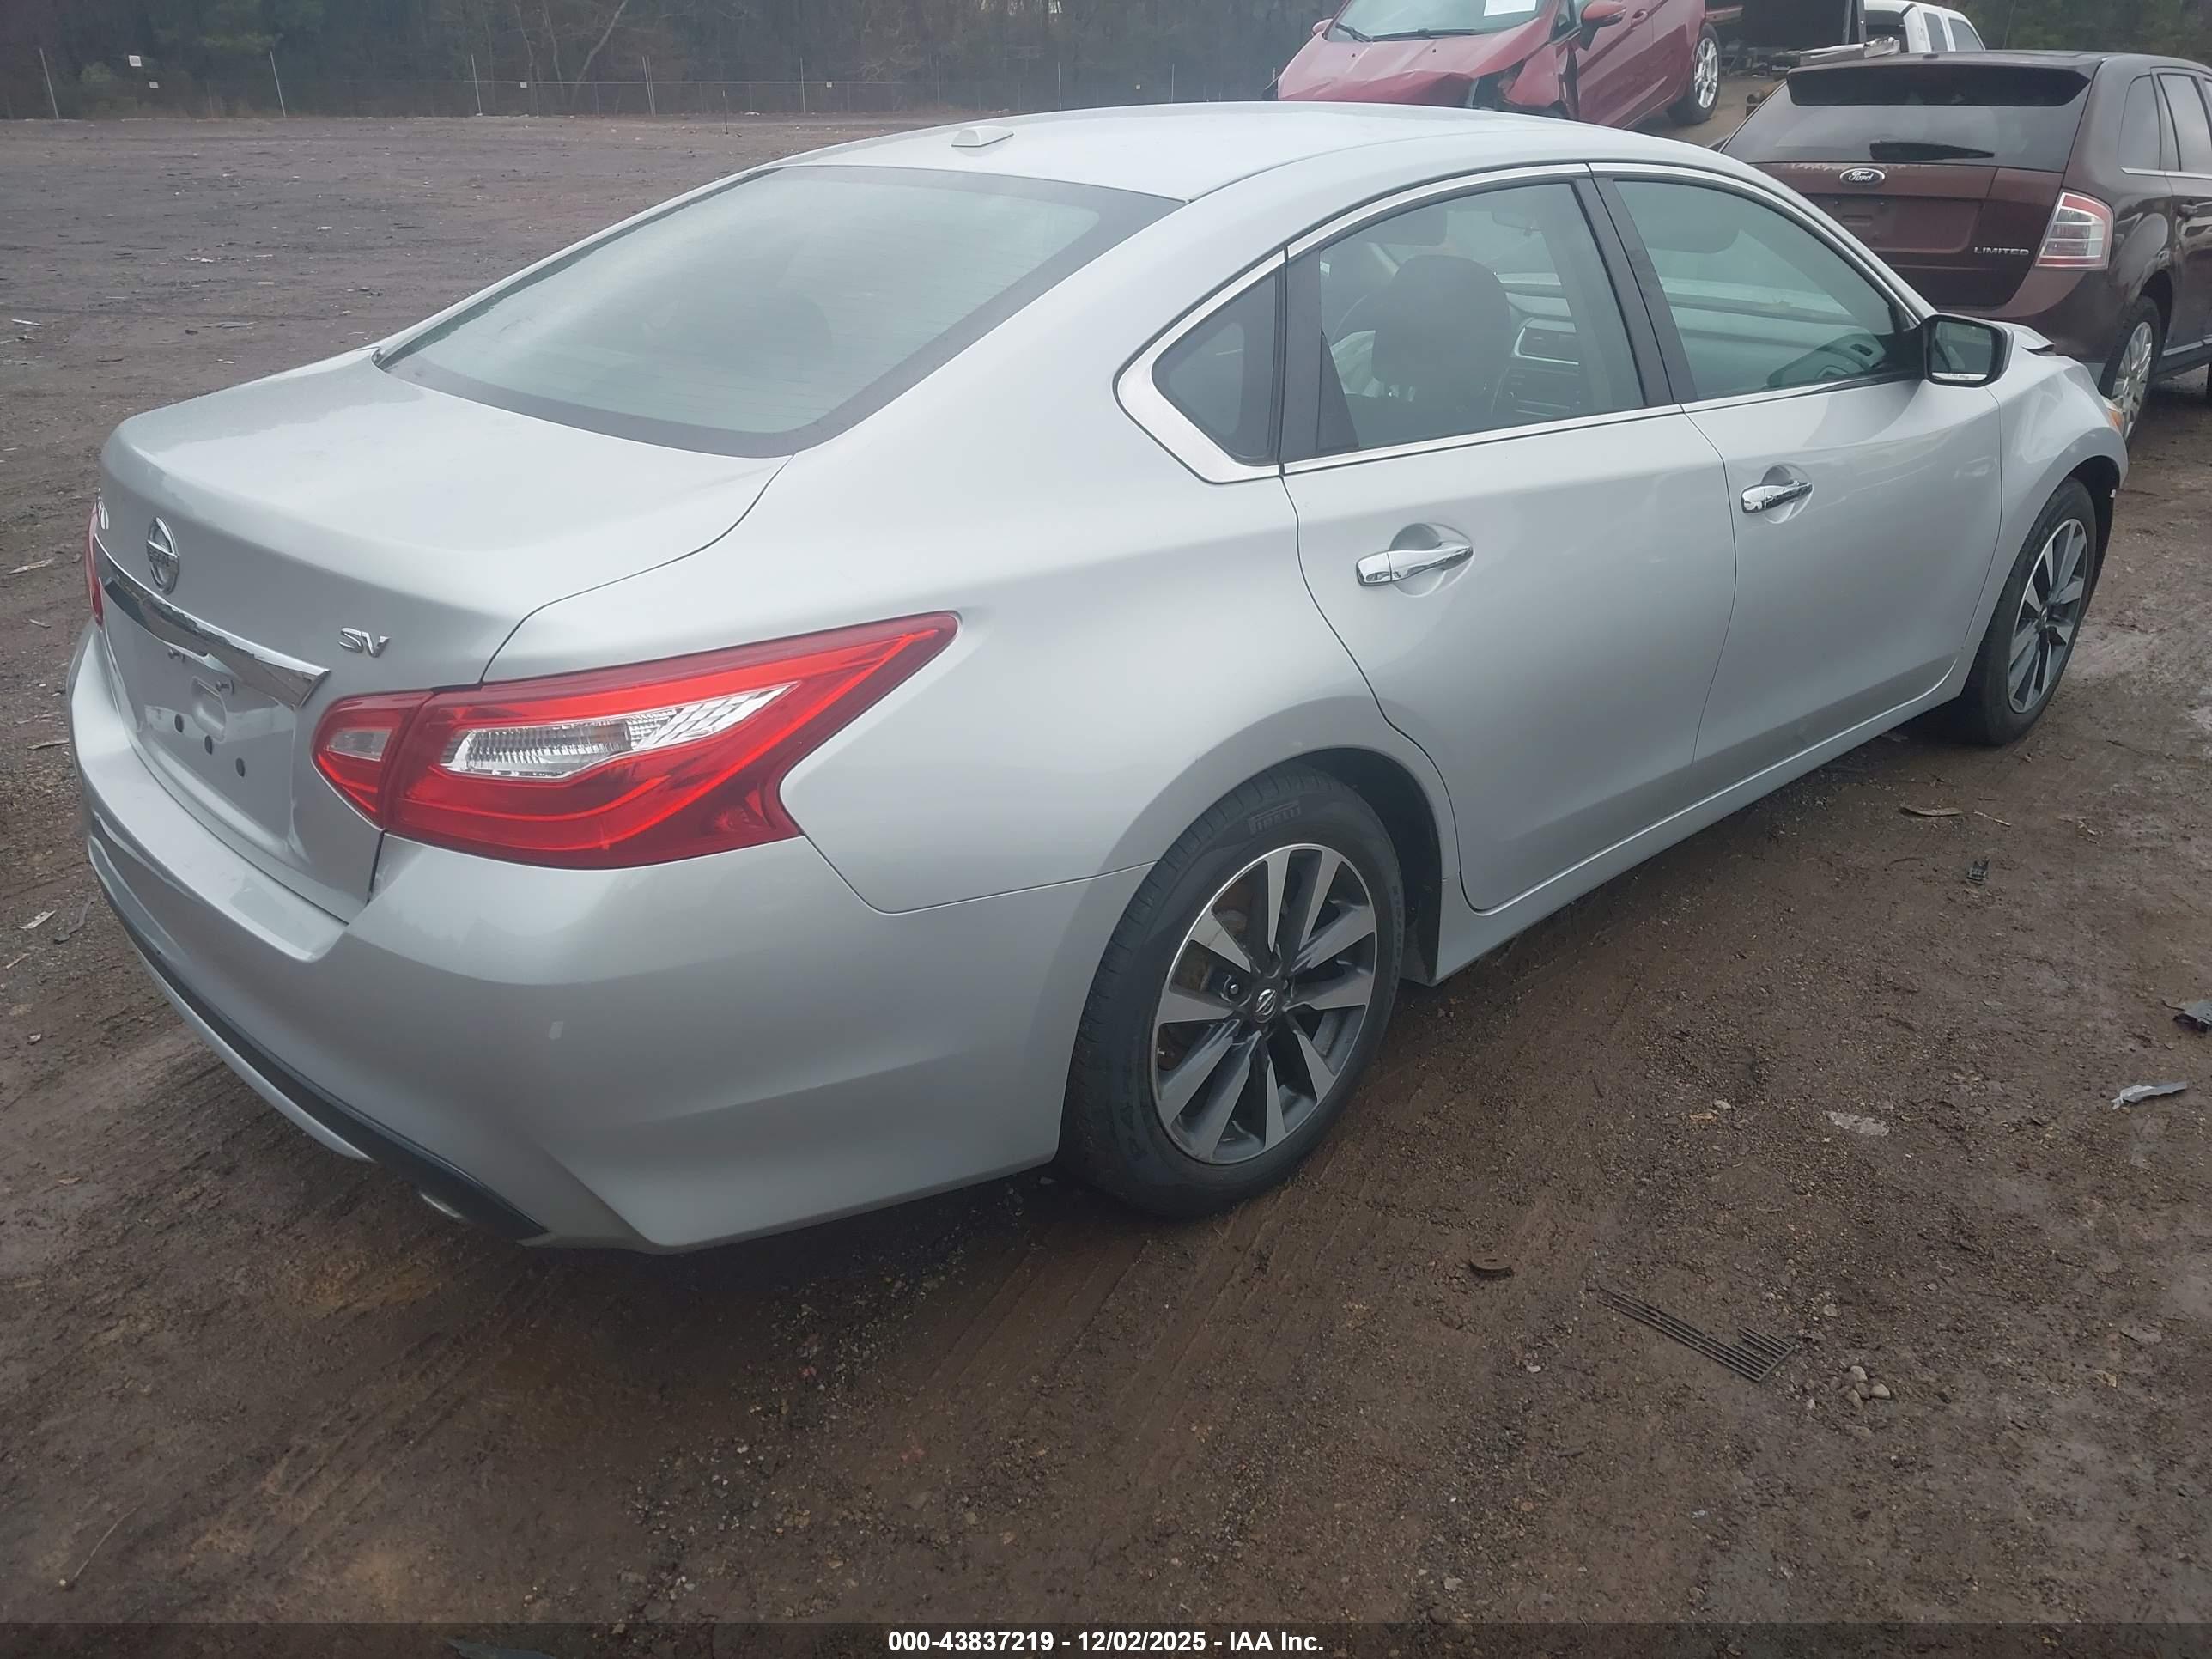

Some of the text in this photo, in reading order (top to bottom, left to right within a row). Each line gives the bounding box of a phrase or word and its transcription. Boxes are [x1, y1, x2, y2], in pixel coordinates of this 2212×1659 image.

[1848, 170, 1875, 181] Ford
[1973, 246, 2030, 256] LIMITED
[338, 627, 391, 659] SV
